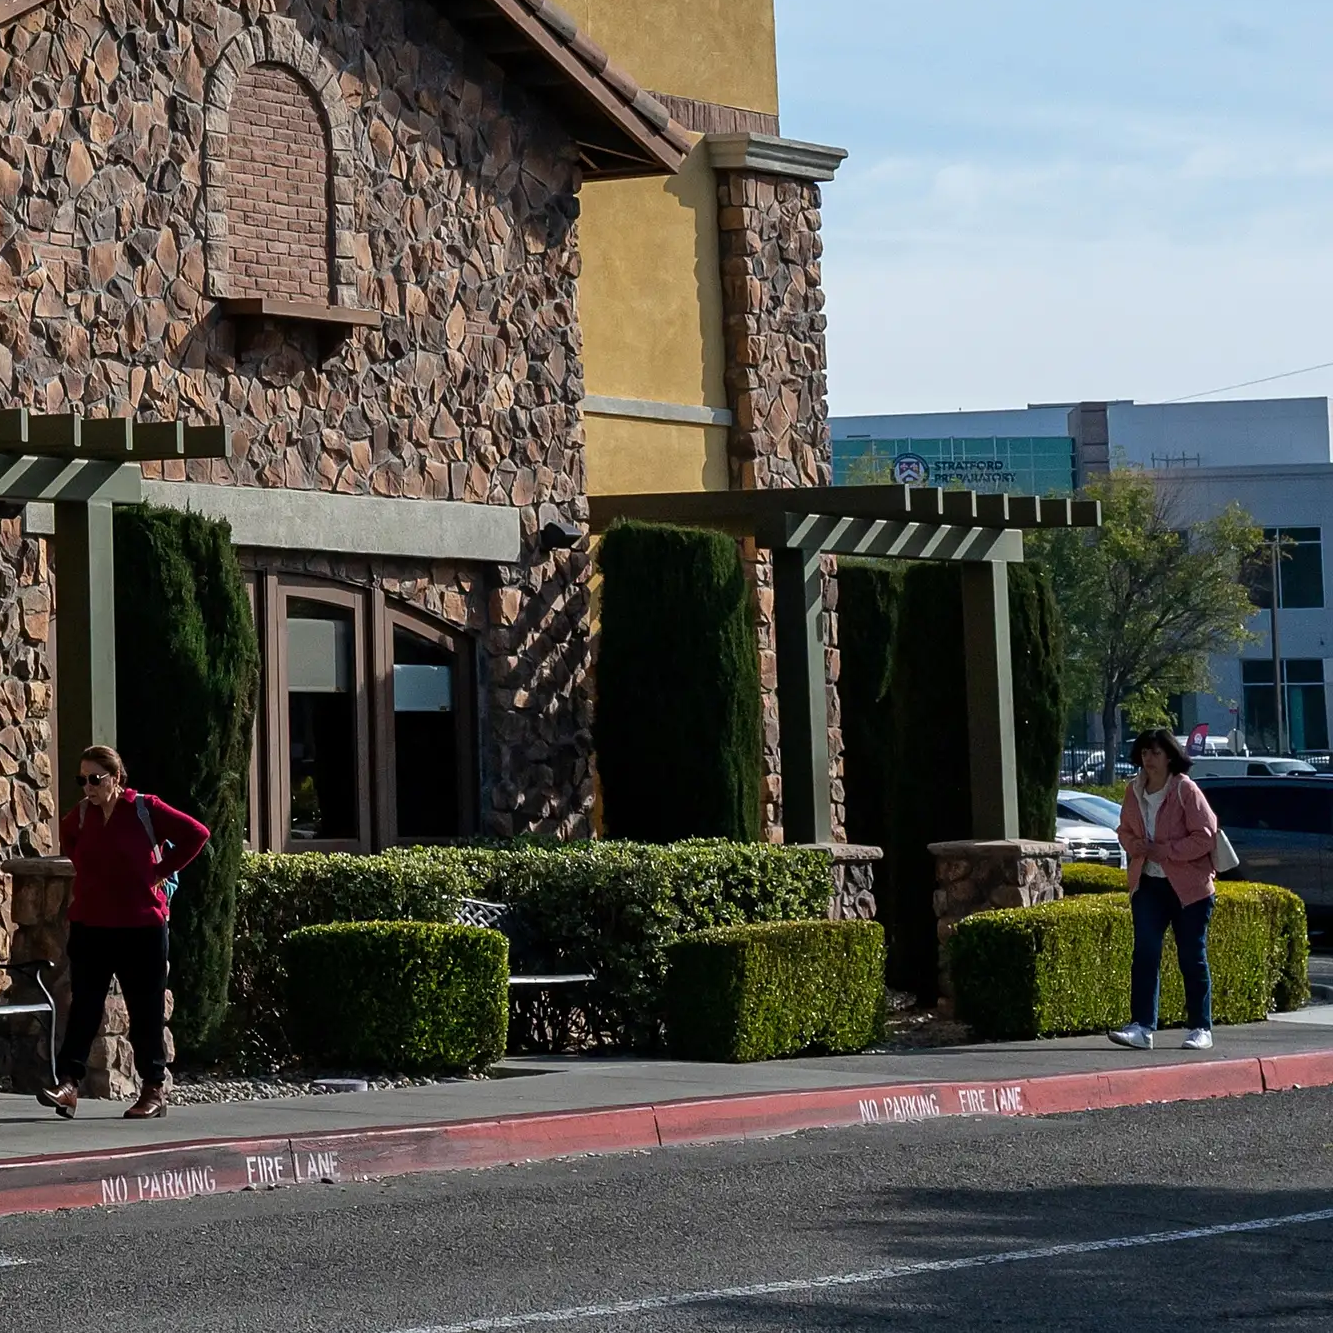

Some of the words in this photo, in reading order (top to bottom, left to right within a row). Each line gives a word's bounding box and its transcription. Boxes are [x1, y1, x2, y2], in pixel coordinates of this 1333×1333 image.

[934, 460, 1004, 471] STRATFORD
[858, 1099, 880, 1122] NO
[883, 1093, 940, 1120] PARKING
[958, 1088, 989, 1113] FIRE
[993, 1086, 1023, 1112] LANE
[100, 1175, 128, 1204] NO
[137, 1165, 216, 1200] PARKING
[245, 1155, 284, 1184] FIRE
[293, 1151, 341, 1184] LANE
